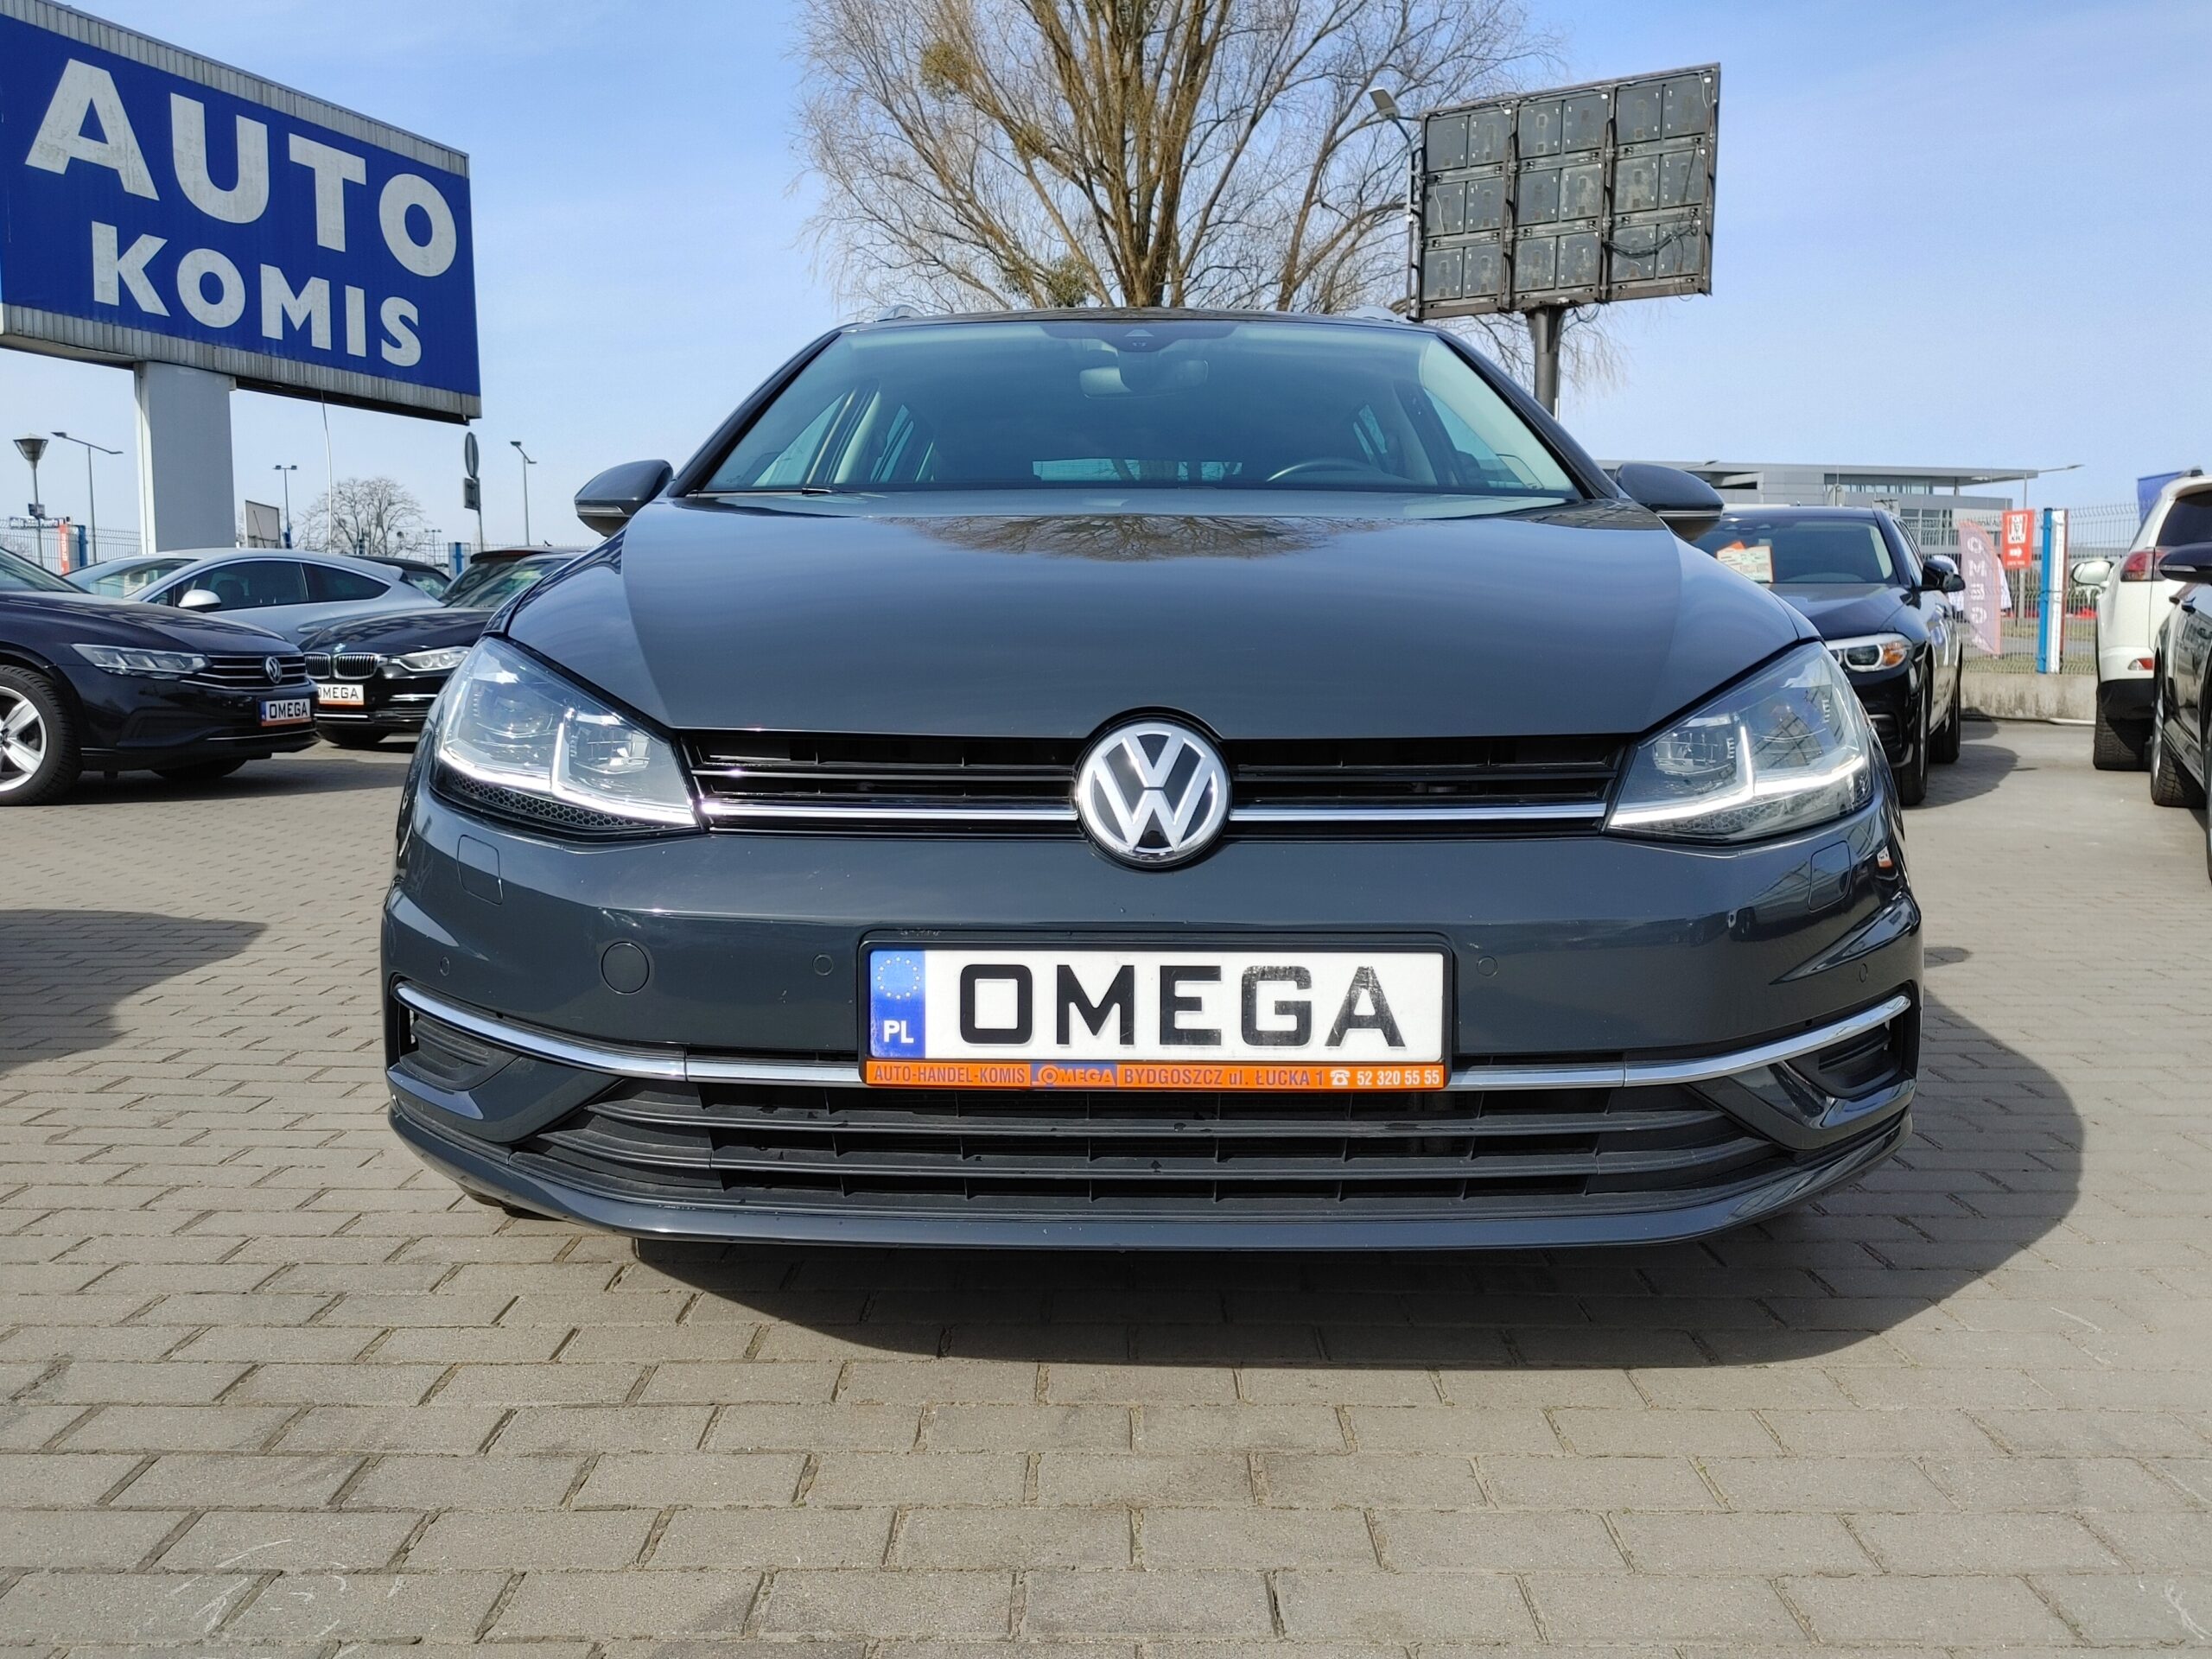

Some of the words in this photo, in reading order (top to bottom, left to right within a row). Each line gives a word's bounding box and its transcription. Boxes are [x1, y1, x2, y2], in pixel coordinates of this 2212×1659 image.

[24, 58, 457, 277] AUTO
[92, 220, 423, 367] KOMIS
[269, 702, 308, 719] OMEGA
[883, 1020, 914, 1044] PL
[960, 964, 1406, 1048] OMEGA
[874, 1065, 1026, 1084] AUTO-HANDEL-KOMIS
[1038, 1065, 1113, 1084] OMEGA
[1123, 1068, 1223, 1085] BYDGOSZCZ
[1229, 1070, 1249, 1085] ul.
[1255, 1070, 1310, 1086] ŁUCKA
[1315, 1071, 1323, 1085] 1
[1357, 1071, 1373, 1086] 52
[1377, 1070, 1401, 1086] 320
[1405, 1070, 1421, 1085] 55
[1425, 1070, 1440, 1085] 55
